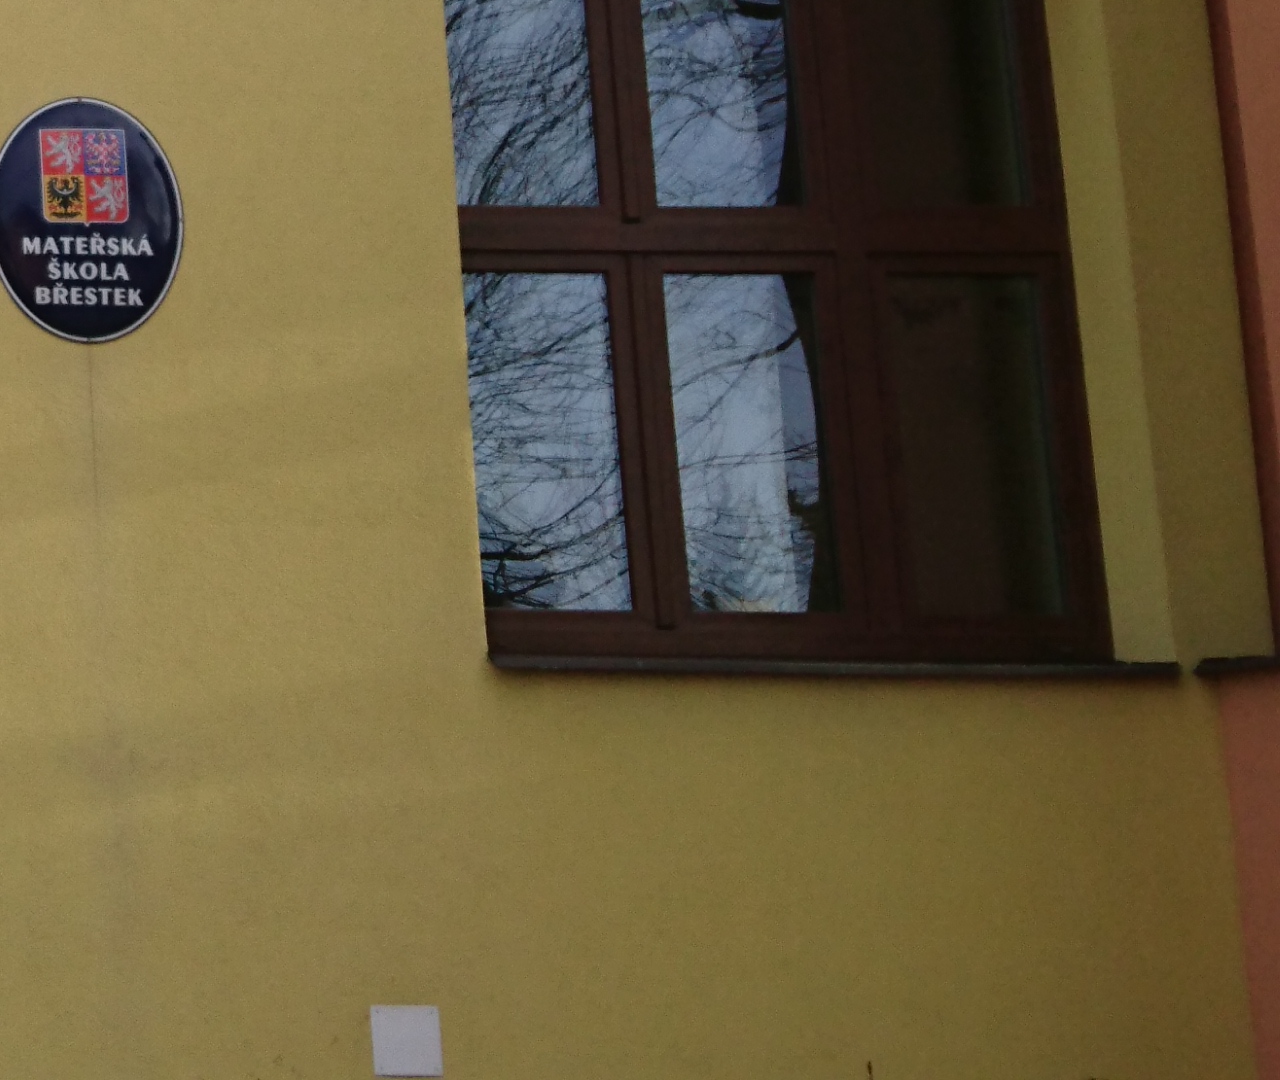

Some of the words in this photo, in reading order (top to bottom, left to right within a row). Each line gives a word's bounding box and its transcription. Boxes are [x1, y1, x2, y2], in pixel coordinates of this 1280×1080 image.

[22, 232, 154, 256] MATEŘSKÁ
[48, 257, 130, 281] ŠKOLA
[34, 282, 144, 306] BŘESTEK
